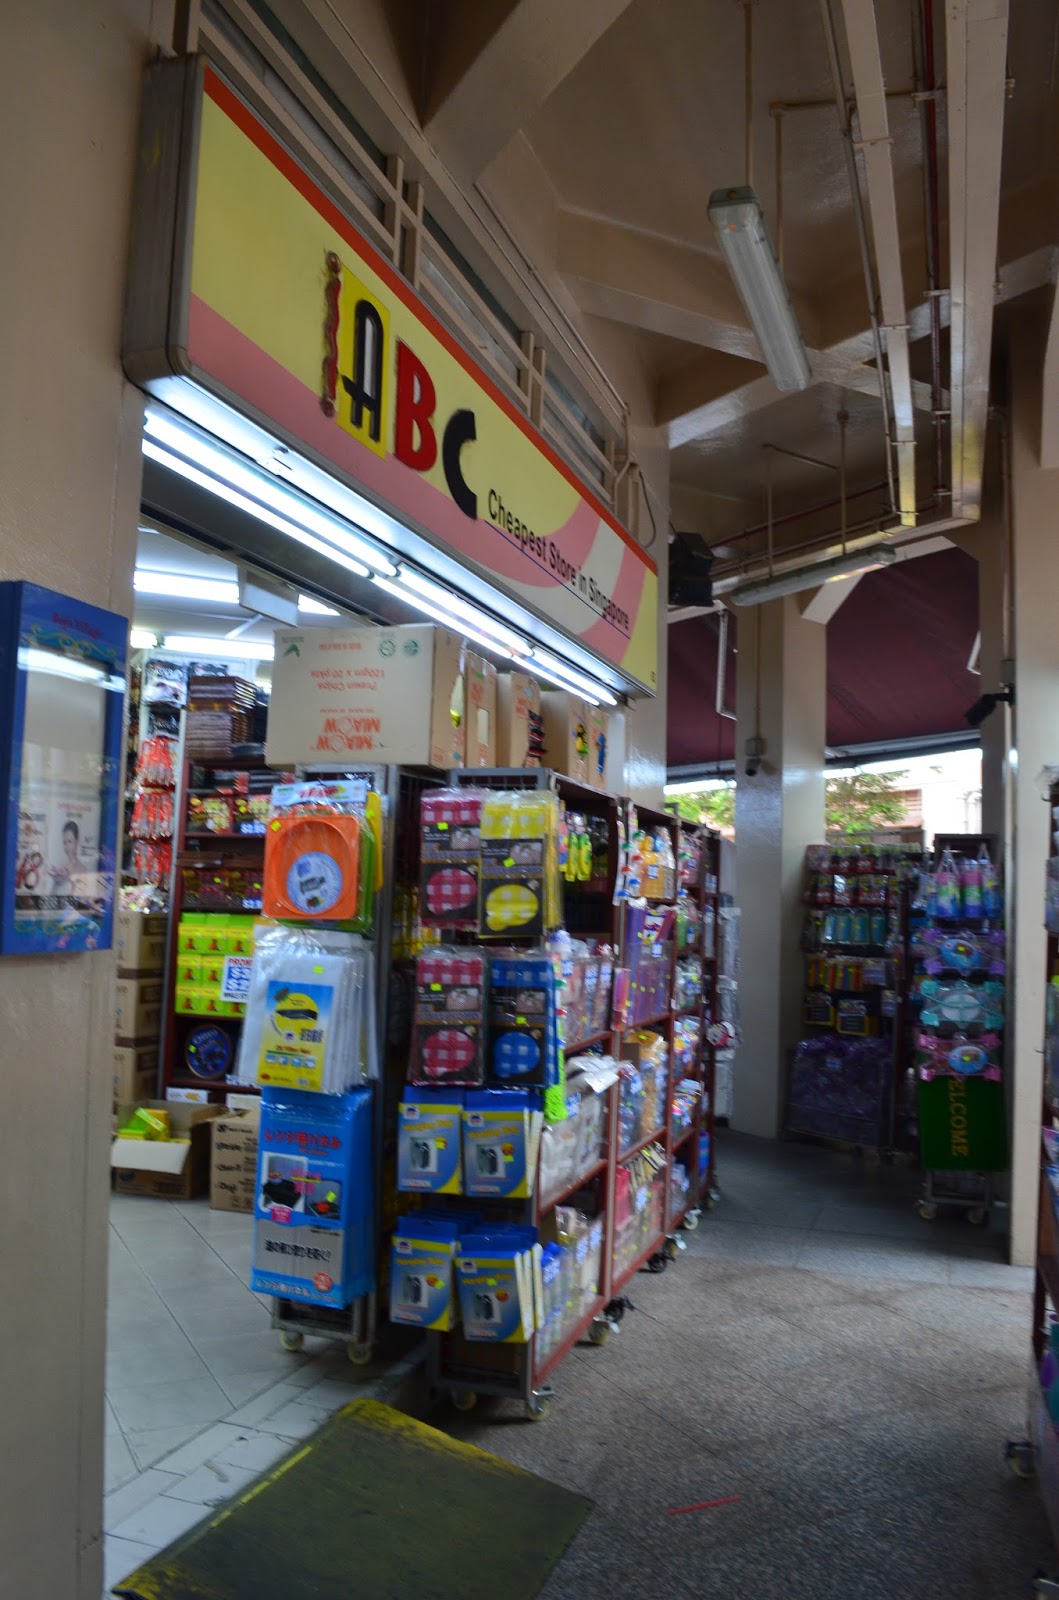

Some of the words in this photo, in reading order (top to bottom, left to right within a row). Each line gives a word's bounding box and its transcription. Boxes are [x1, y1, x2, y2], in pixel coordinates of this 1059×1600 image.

[341, 299, 478, 520] ABC
[488, 488, 547, 563] Cheapest
[549, 542, 576, 586] Store
[578, 565, 589, 596] in
[588, 577, 630, 630] Singapore
[948, 1078, 969, 1156] ELCOME
